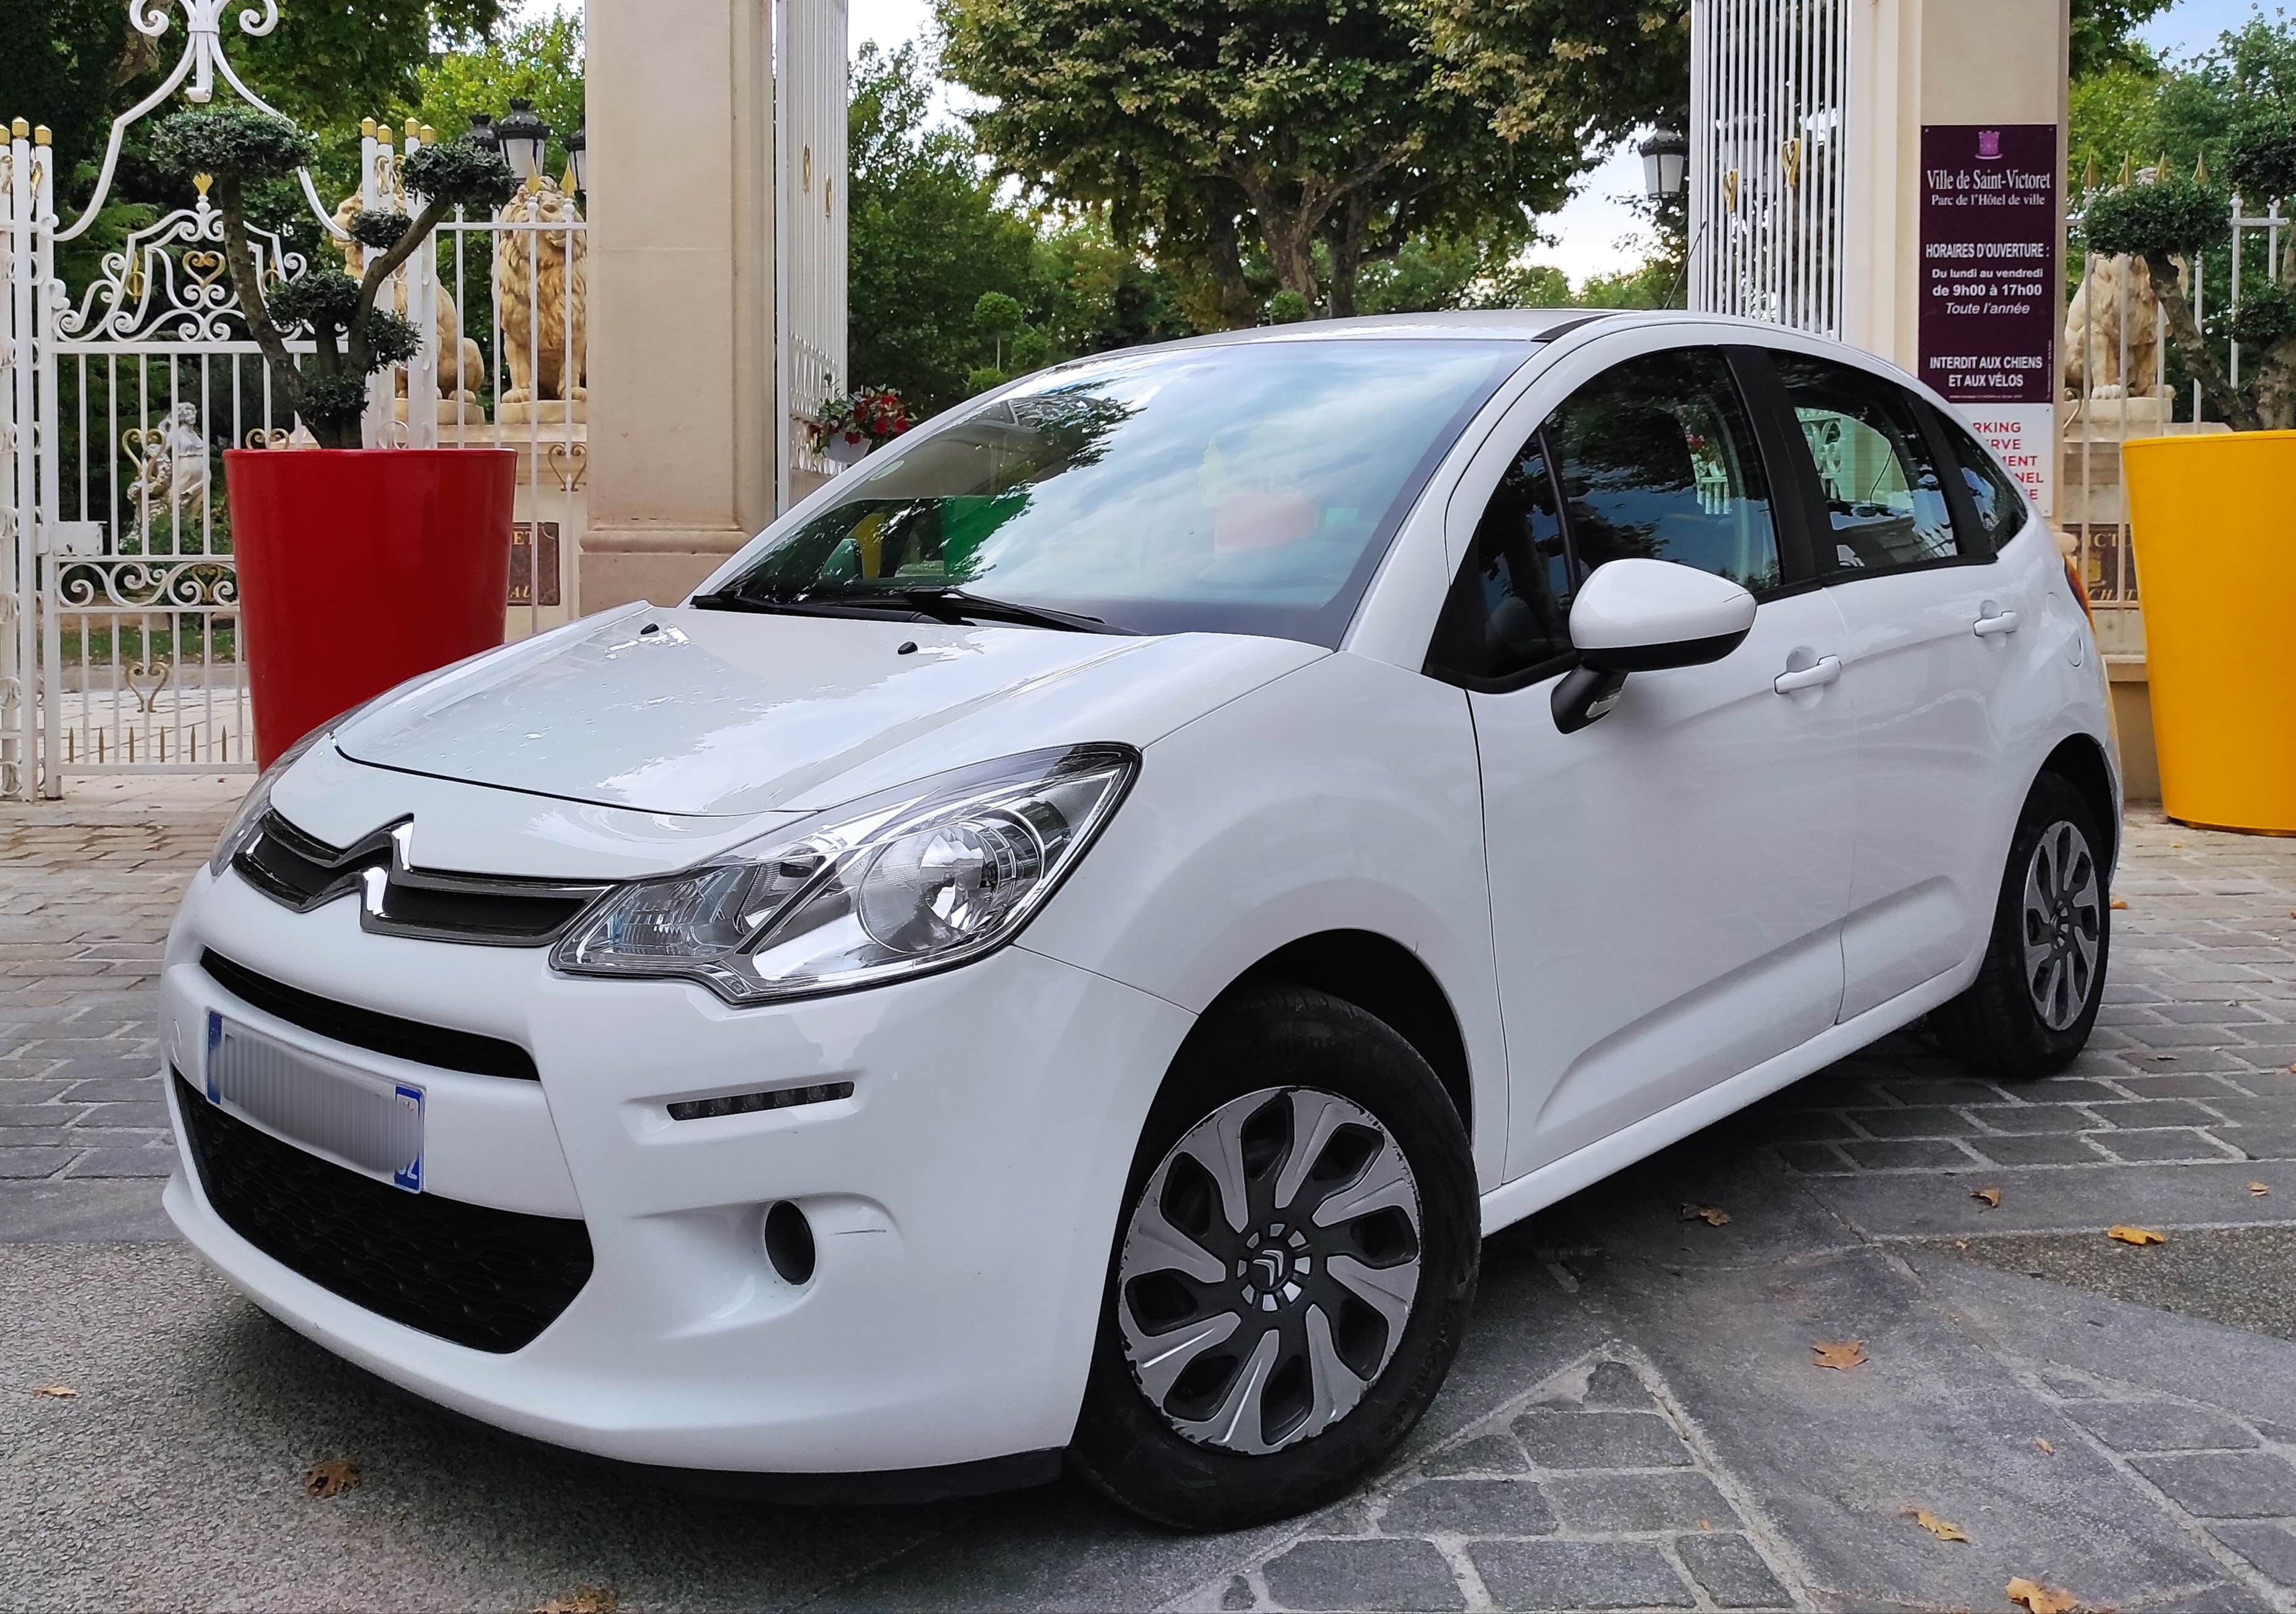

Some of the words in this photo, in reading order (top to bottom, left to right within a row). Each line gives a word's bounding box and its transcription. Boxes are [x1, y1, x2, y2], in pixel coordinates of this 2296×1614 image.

[1927, 170, 1954, 189] Ville
[1956, 170, 1970, 189] de
[1973, 169, 2051, 189] Saint-Victoret
[1932, 195, 1953, 205] Parc
[1956, 194, 1968, 205] de
[1971, 194, 2006, 205] l'Hôtel
[2008, 194, 2020, 205] de
[2023, 194, 2045, 205] ville
[1926, 243, 1975, 258] HORAIRES
[1977, 243, 2044, 258] D'OUVERTURE
[1932, 269, 1947, 278] Du
[1950, 269, 1977, 278] lundi
[1980, 270, 1993, 278] au
[1996, 268, 2043, 277] vendredi
[1933, 284, 1949, 296] de
[1953, 284, 1986, 296] 9h00
[1989, 284, 1997, 295] à
[2001, 284, 2042, 296] 17h00
[1946, 303, 1980, 314] Toute
[1983, 302, 2030, 314] l'année
[1930, 357, 1977, 369] INTERDIT
[1979, 357, 2001, 369] AUX
[2004, 357, 2043, 369] CHIENS
[1949, 374, 1962, 387] ET
[1964, 374, 1986, 387] AUX
[1988, 371, 2023, 387] VÉLOS
[1986, 439, 2021, 450] RVE
[2002, 455, 2038, 466] ENT
